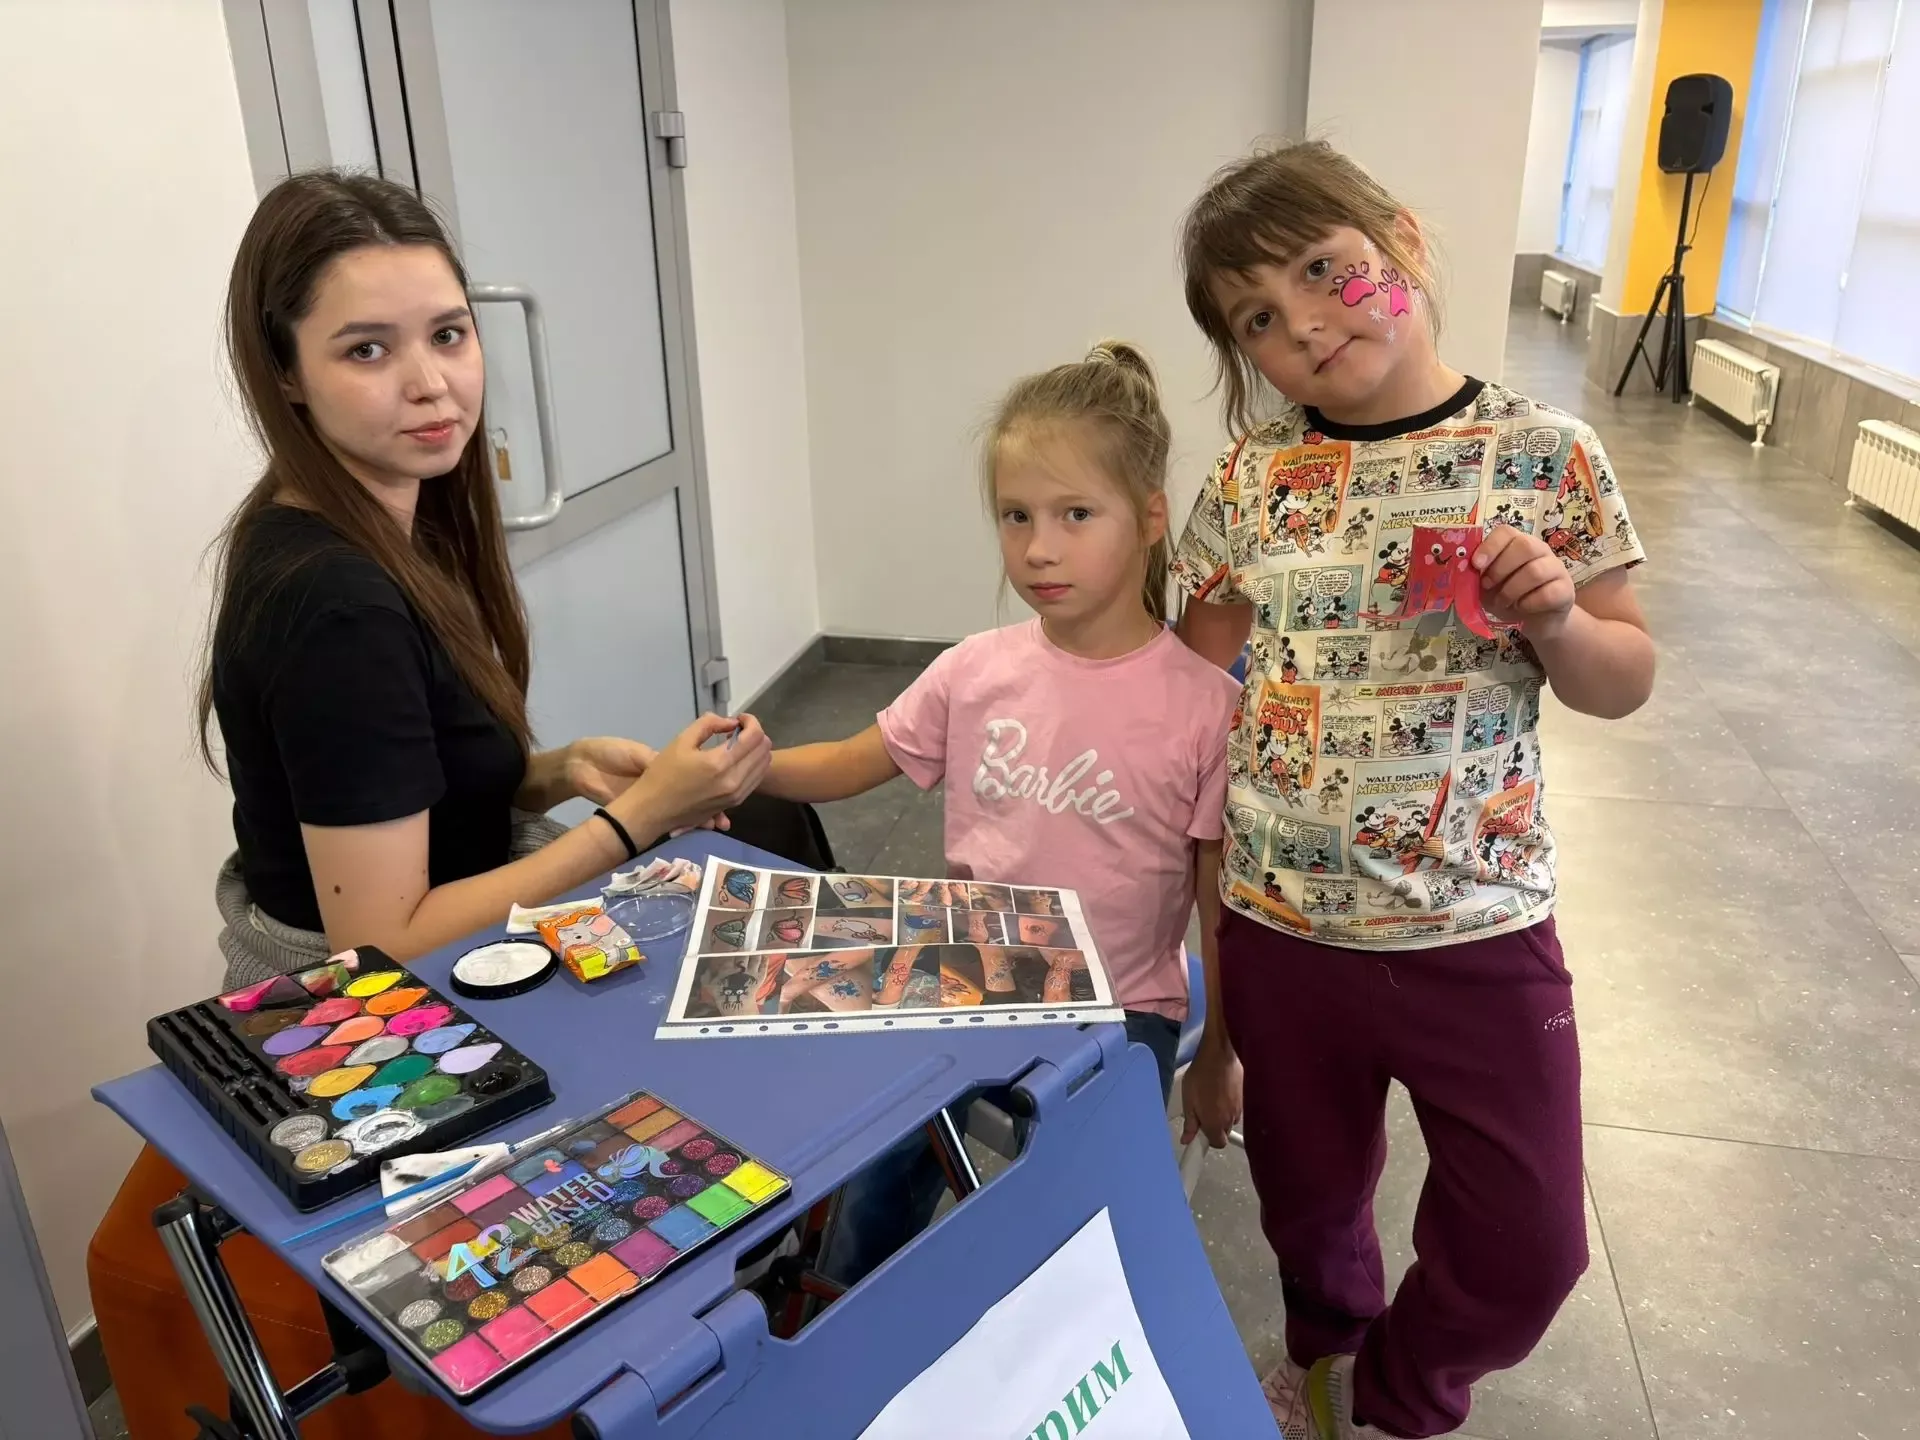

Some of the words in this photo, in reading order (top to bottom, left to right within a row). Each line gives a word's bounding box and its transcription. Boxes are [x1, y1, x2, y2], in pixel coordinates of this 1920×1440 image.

[1390, 509, 1417, 518] WALT
[1419, 505, 1466, 515] DISNEY'S
[1375, 684, 1423, 697] MICKEY
[973, 718, 1134, 824] Barbie
[1366, 775, 1392, 783] WALT
[1395, 771, 1440, 782] DISNEY'S
[1356, 782, 1403, 796] MICKEY
[510, 1172, 597, 1226] WATER
[532, 1181, 615, 1236] BASED
[1025, 1340, 1133, 1440] рим
